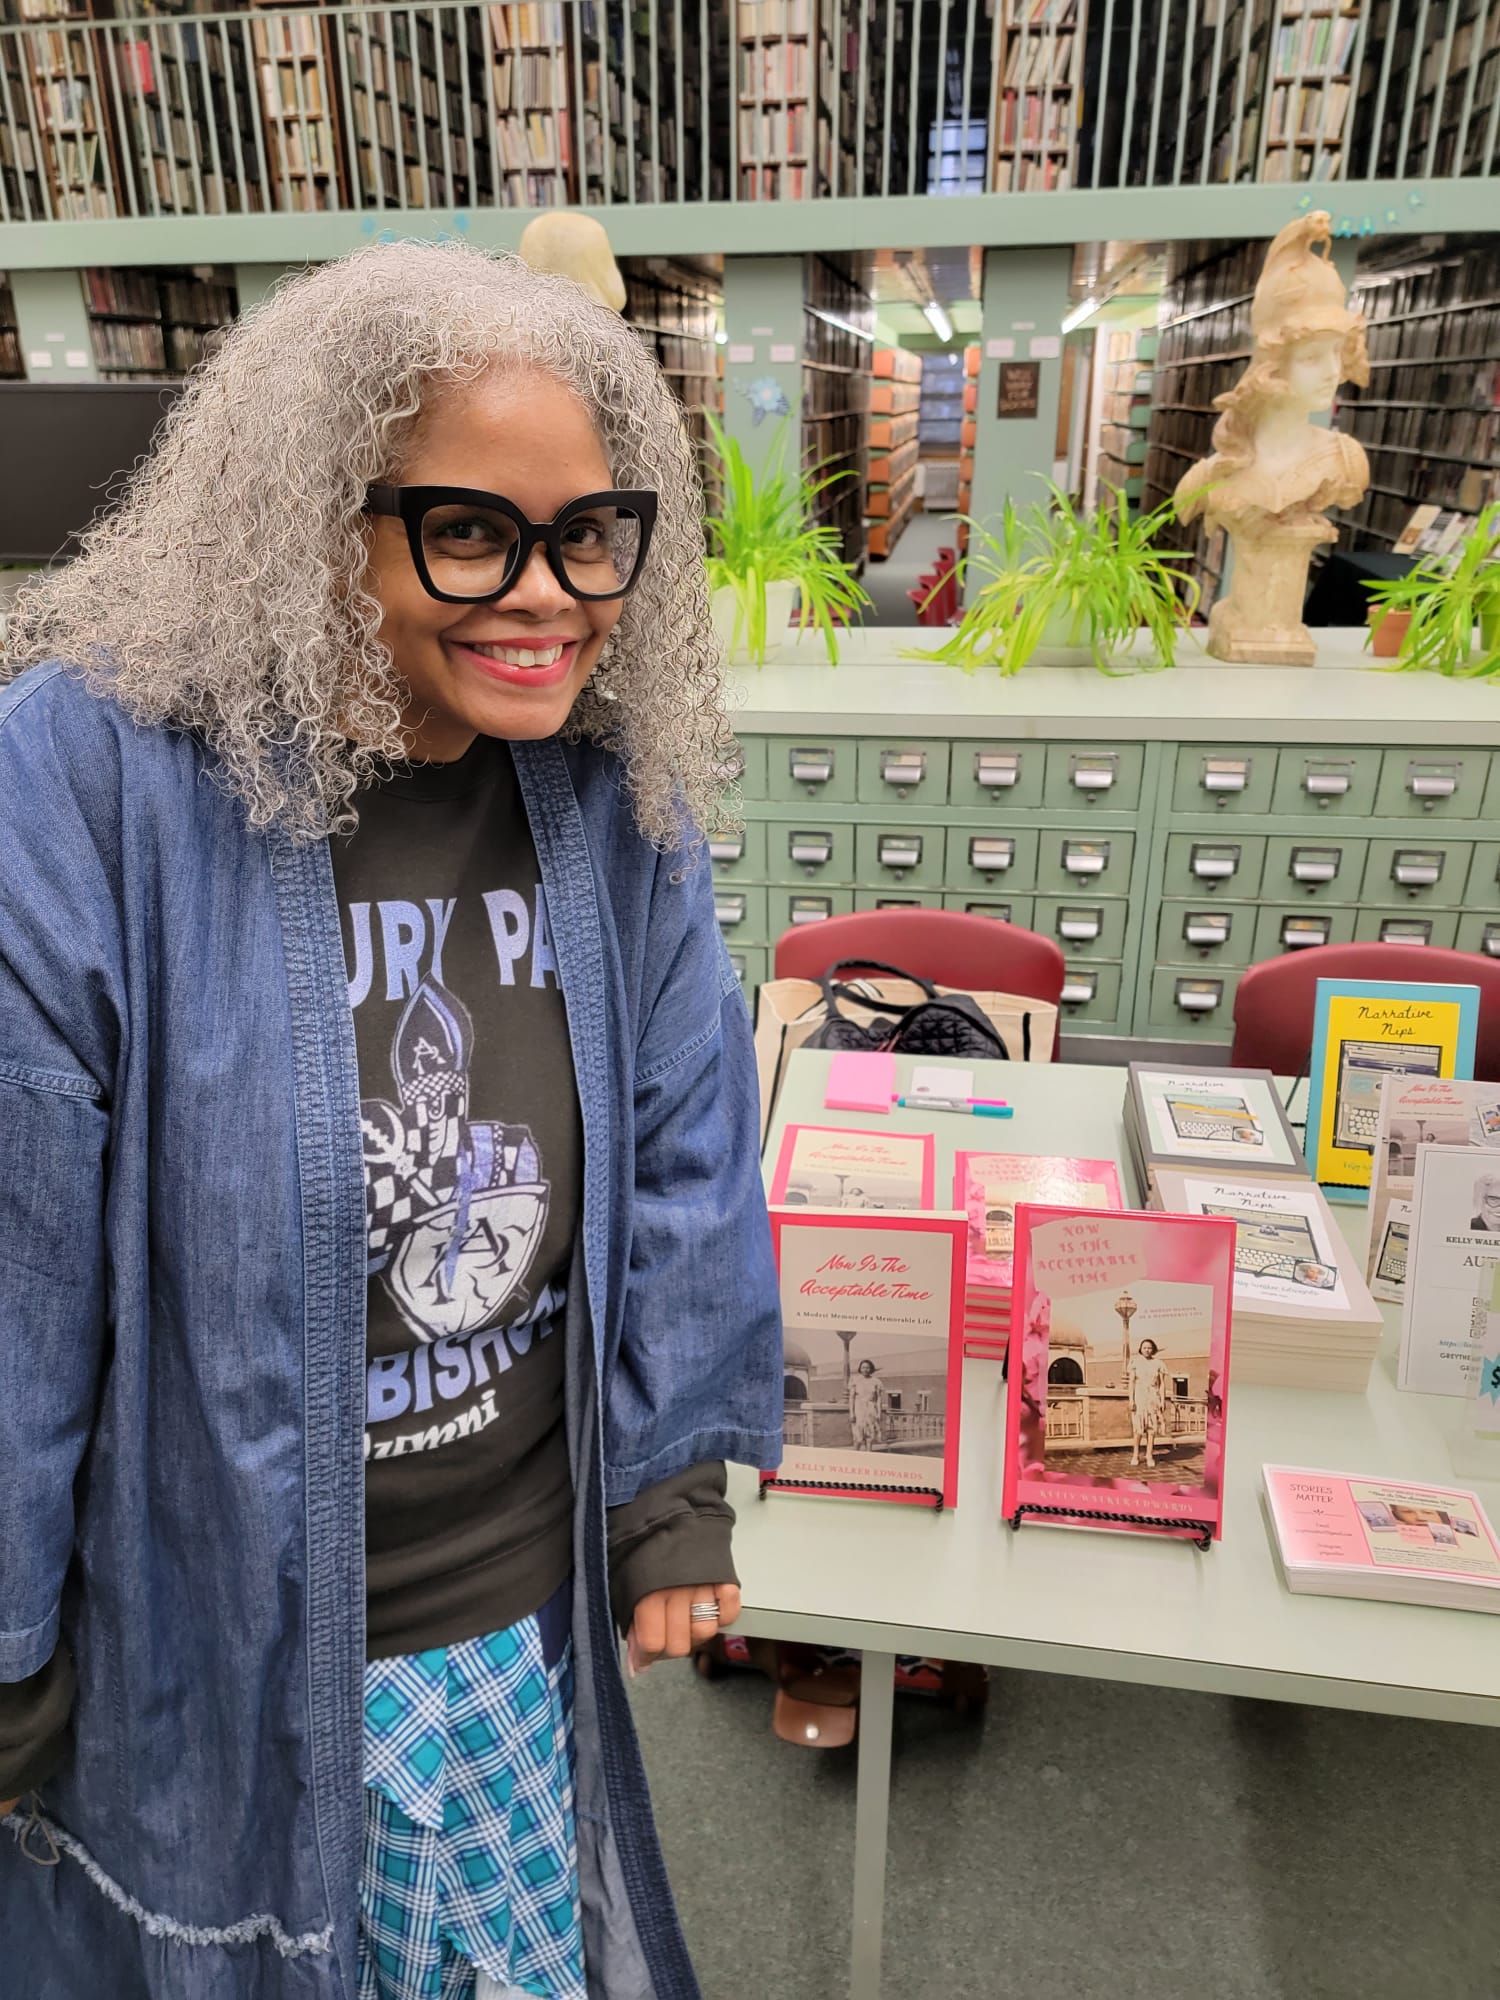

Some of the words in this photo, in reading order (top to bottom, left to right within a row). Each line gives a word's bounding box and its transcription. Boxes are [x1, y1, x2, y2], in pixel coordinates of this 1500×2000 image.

[1358, 1004, 1434, 1020] Narrative
[1381, 1022, 1415, 1038] Nips
[1213, 1186, 1291, 1201] Narrative
[1062, 1223, 1100, 1237] NOW
[1058, 1242, 1075, 1254] IS
[1079, 1239, 1112, 1251] THE
[1446, 1236, 1472, 1245] KELLY
[816, 1254, 856, 1273] Now
[857, 1254, 879, 1272] Is
[880, 1257, 911, 1273] The
[1037, 1253, 1138, 1272] ACCEPTABLE
[1068, 1271, 1109, 1285] TIME
[800, 1279, 891, 1302] Acceptable
[891, 1283, 933, 1301] Time
[803, 1311, 829, 1319] Modest
[830, 1312, 859, 1321] Memoir
[860, 1313, 869, 1321] of
[876, 1315, 915, 1324] Memorable
[917, 1317, 932, 1325] Life
[795, 1463, 826, 1473] KELLY
[828, 1465, 870, 1476] WALKER
[873, 1469, 923, 1480] EDWARDS
[1289, 1483, 1333, 1495] STORIES
[1295, 1493, 1335, 1504] MATTER
